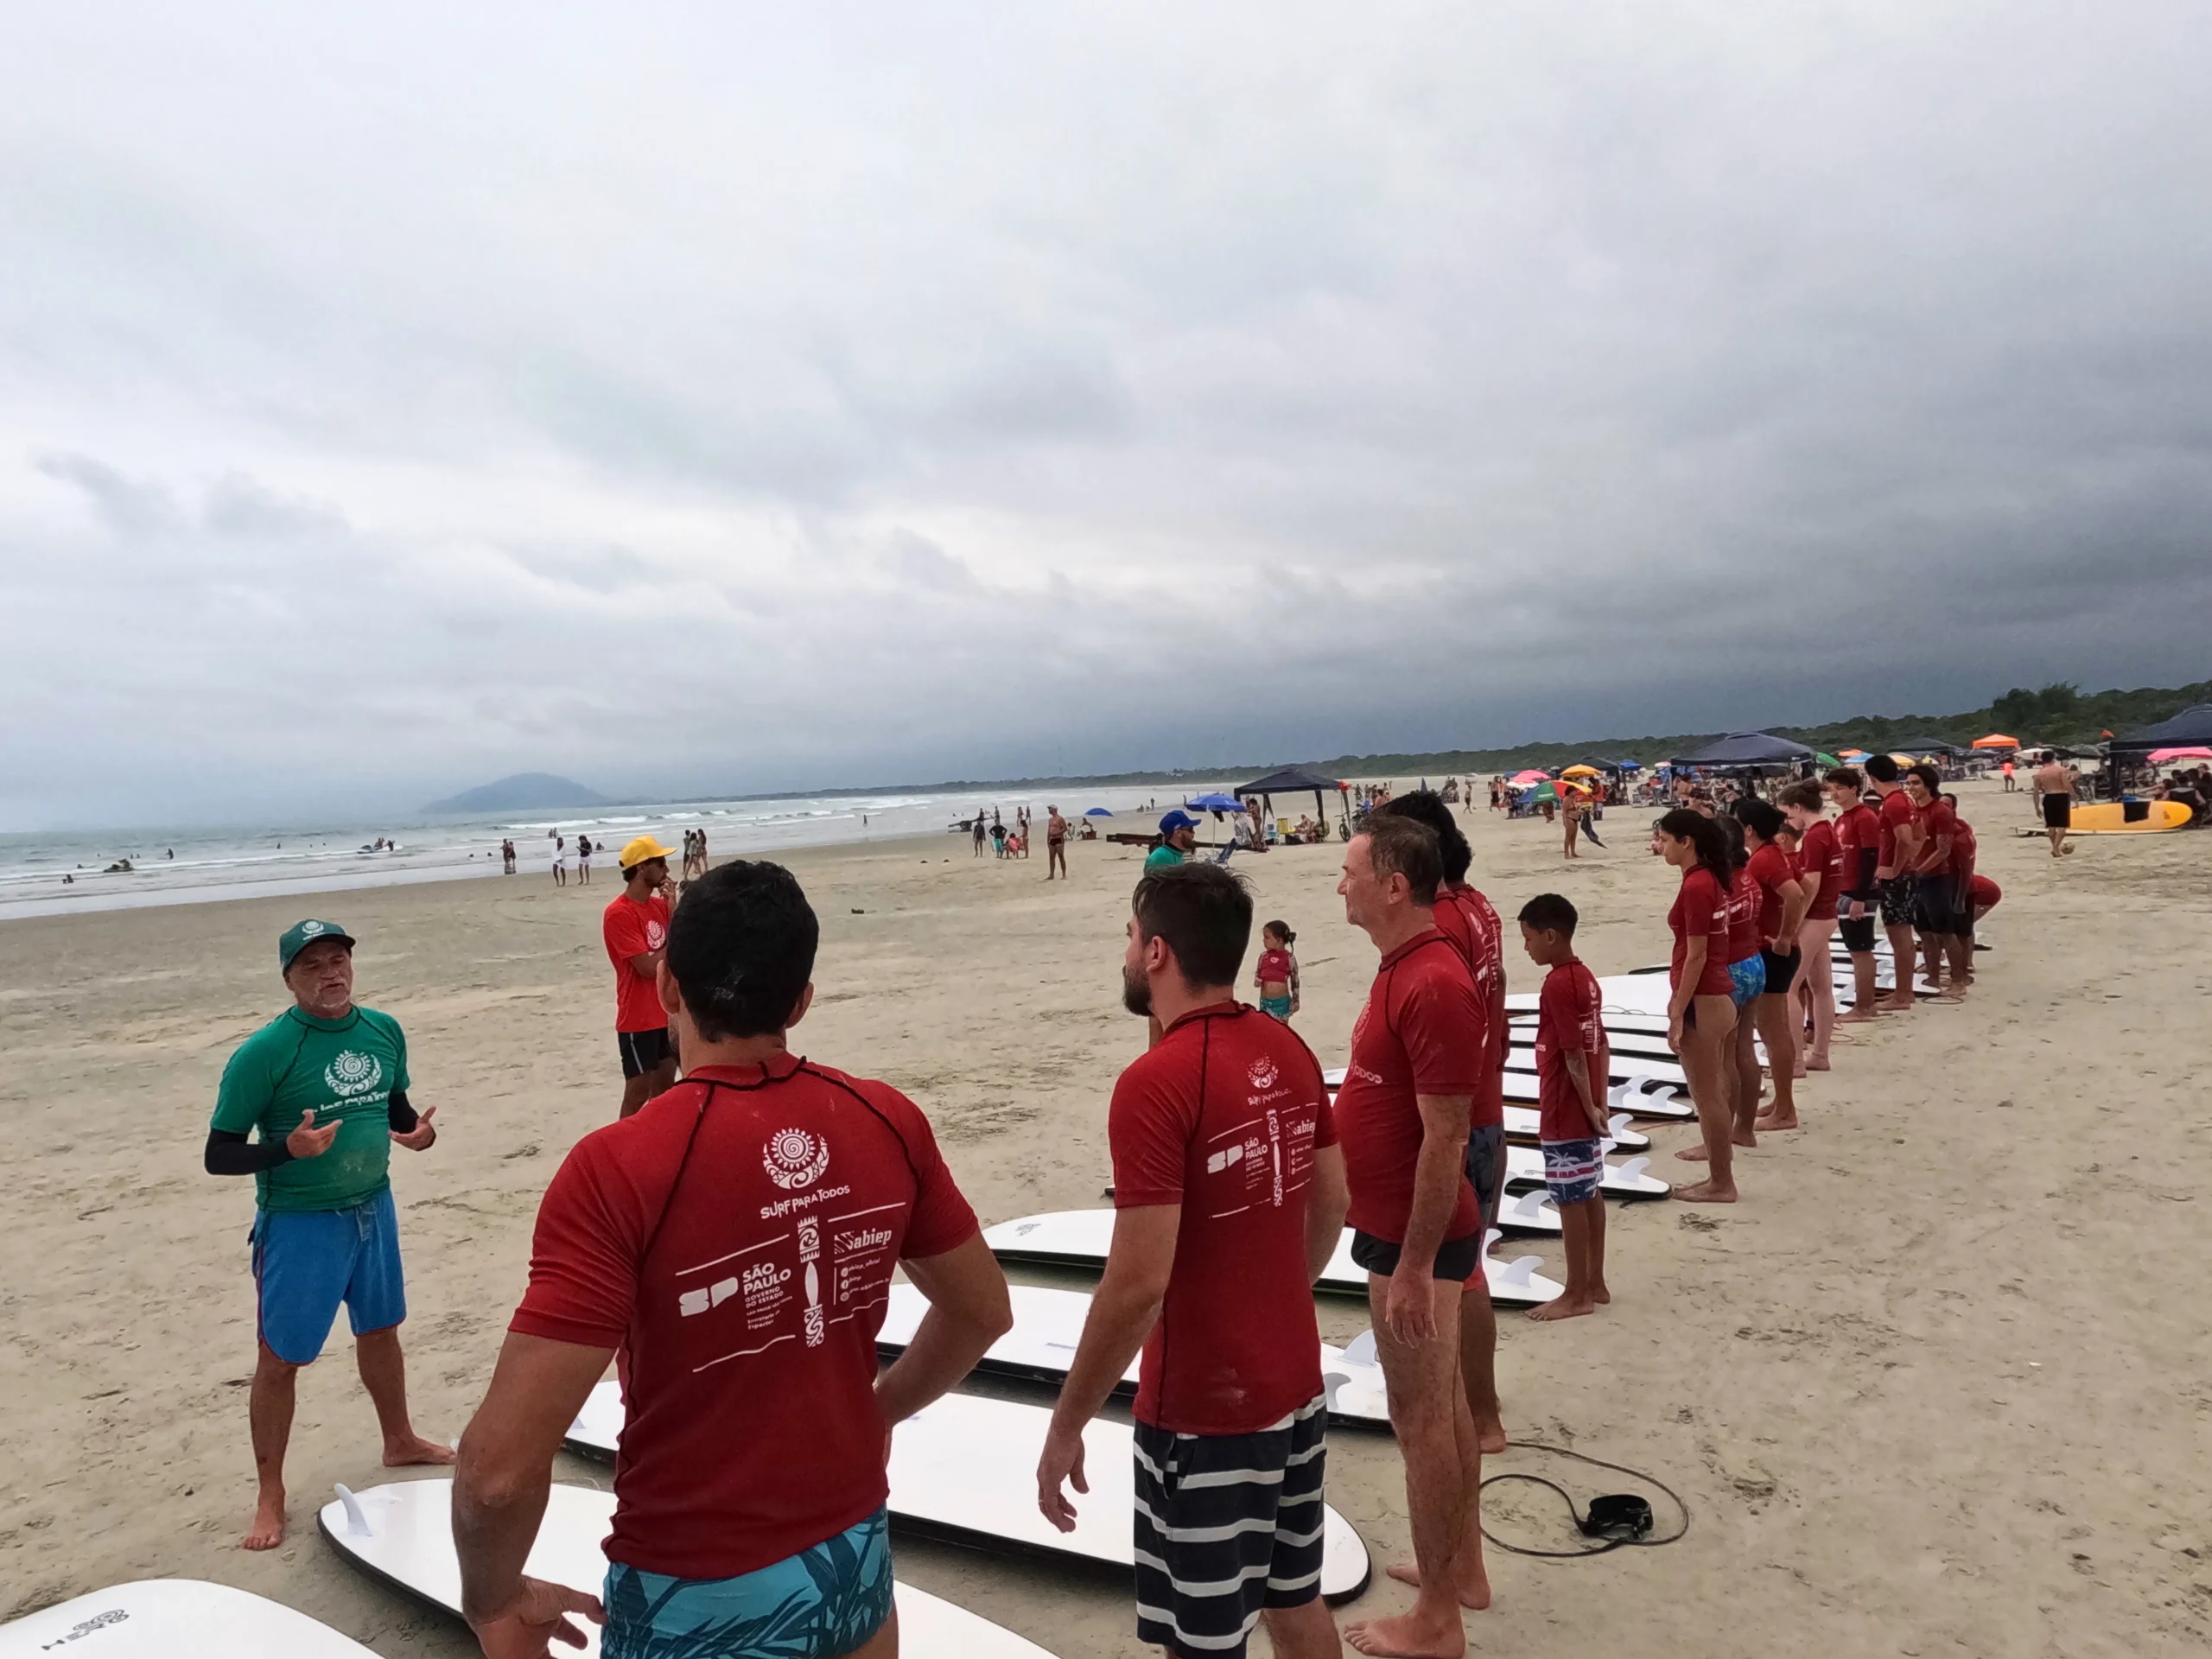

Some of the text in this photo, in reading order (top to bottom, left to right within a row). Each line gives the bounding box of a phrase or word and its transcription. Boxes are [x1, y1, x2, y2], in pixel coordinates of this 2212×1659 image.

[1244, 1136, 1259, 1150] SÃO
[1245, 1144, 1268, 1160] PAULO
[760, 1185, 850, 1219] SURF PARA TODOS
[834, 1227, 893, 1255] Sabiep
[742, 1262, 775, 1283] SÃO
[743, 1268, 791, 1296] PAULO
[745, 1286, 780, 1302] GOVERNO
[746, 1300, 757, 1309] DO
[758, 1290, 784, 1304] ESTADO
